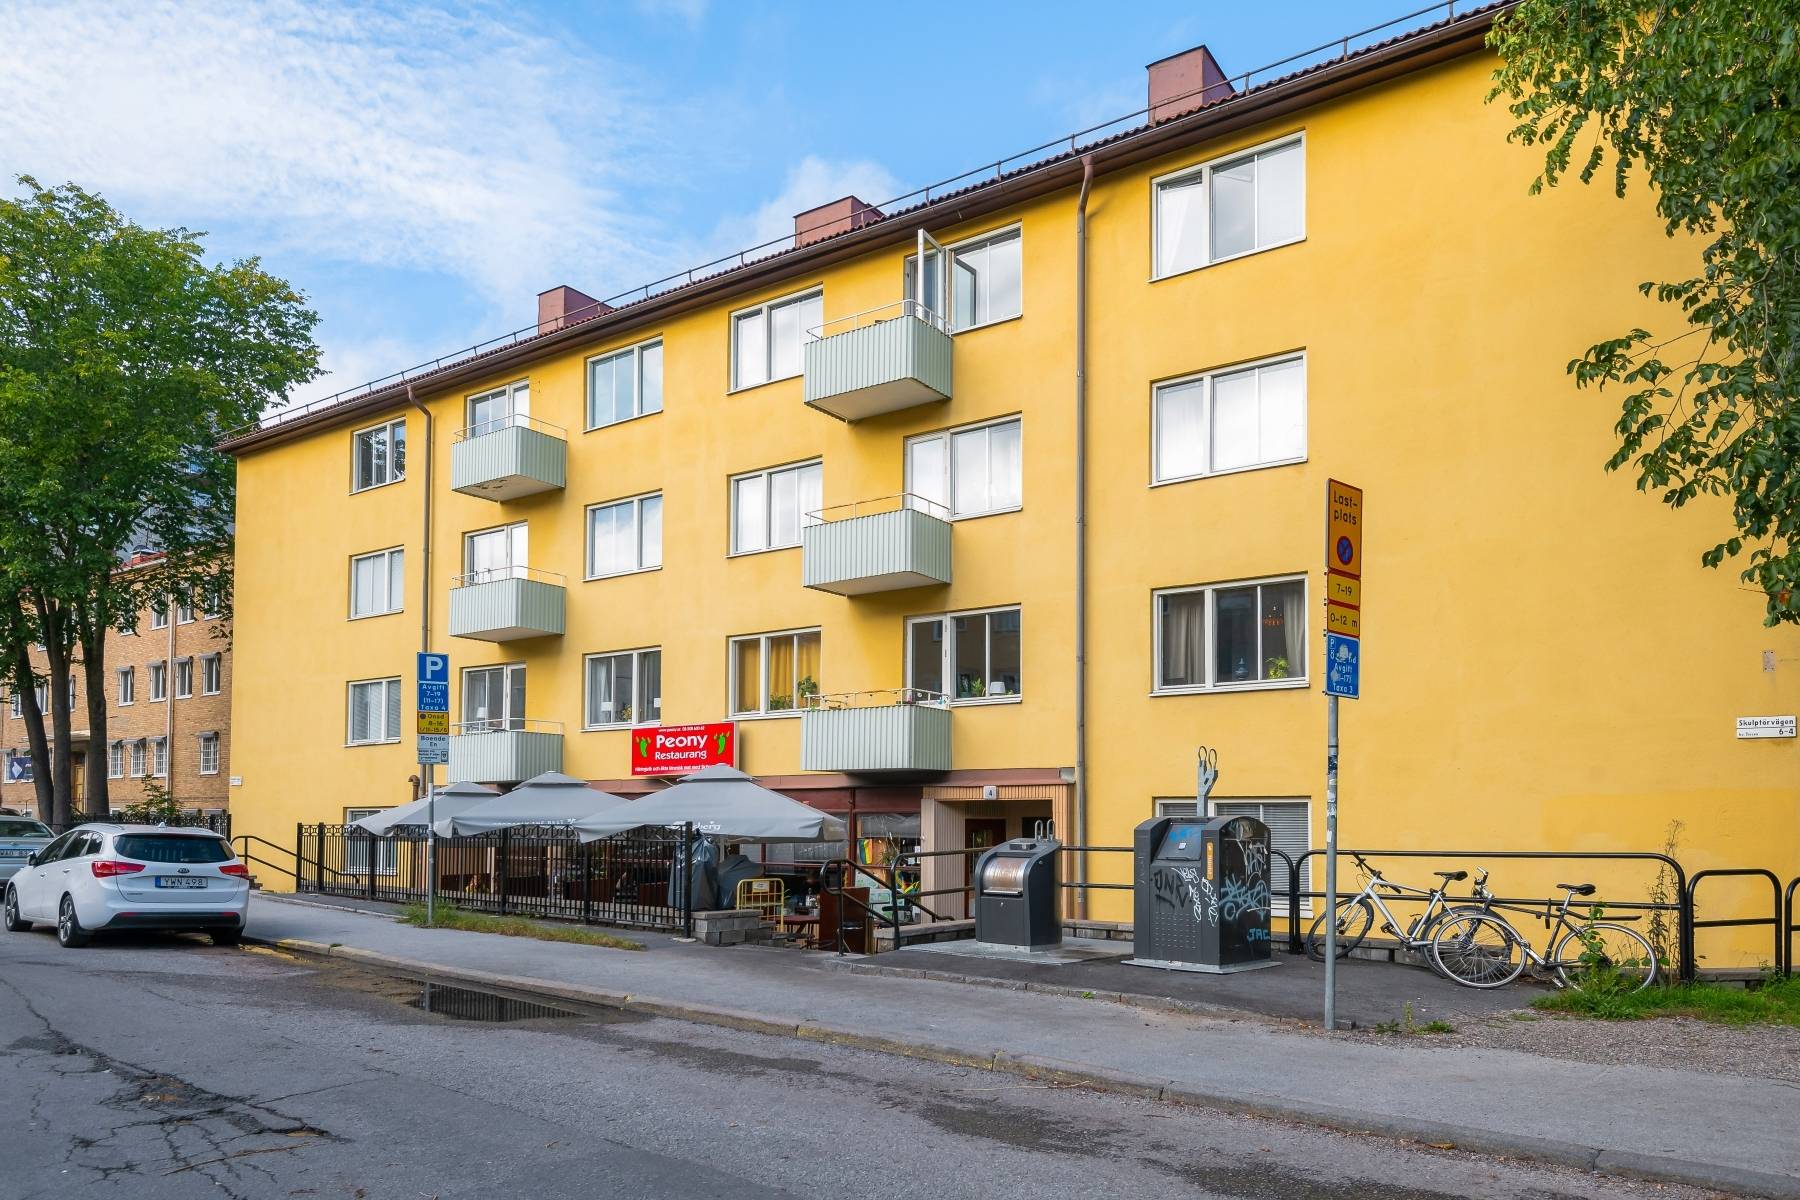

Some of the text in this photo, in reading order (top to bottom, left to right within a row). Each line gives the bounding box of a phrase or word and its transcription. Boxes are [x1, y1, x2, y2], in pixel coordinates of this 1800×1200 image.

[1333, 490, 1358, 507] Last-
[1333, 508, 1357, 526] plats
[1336, 583, 1352, 596] 7-19
[1330, 612, 1358, 628] 0-12 m
[425, 656, 443, 680] P
[422, 683, 445, 691] Avgift
[1333, 683, 1348, 693] Taxa
[1738, 718, 1794, 726] Skulptörvägen
[656, 734, 708, 748] Peony
[655, 750, 707, 760] Restaurang
[164, 877, 203, 886] YWN 498
